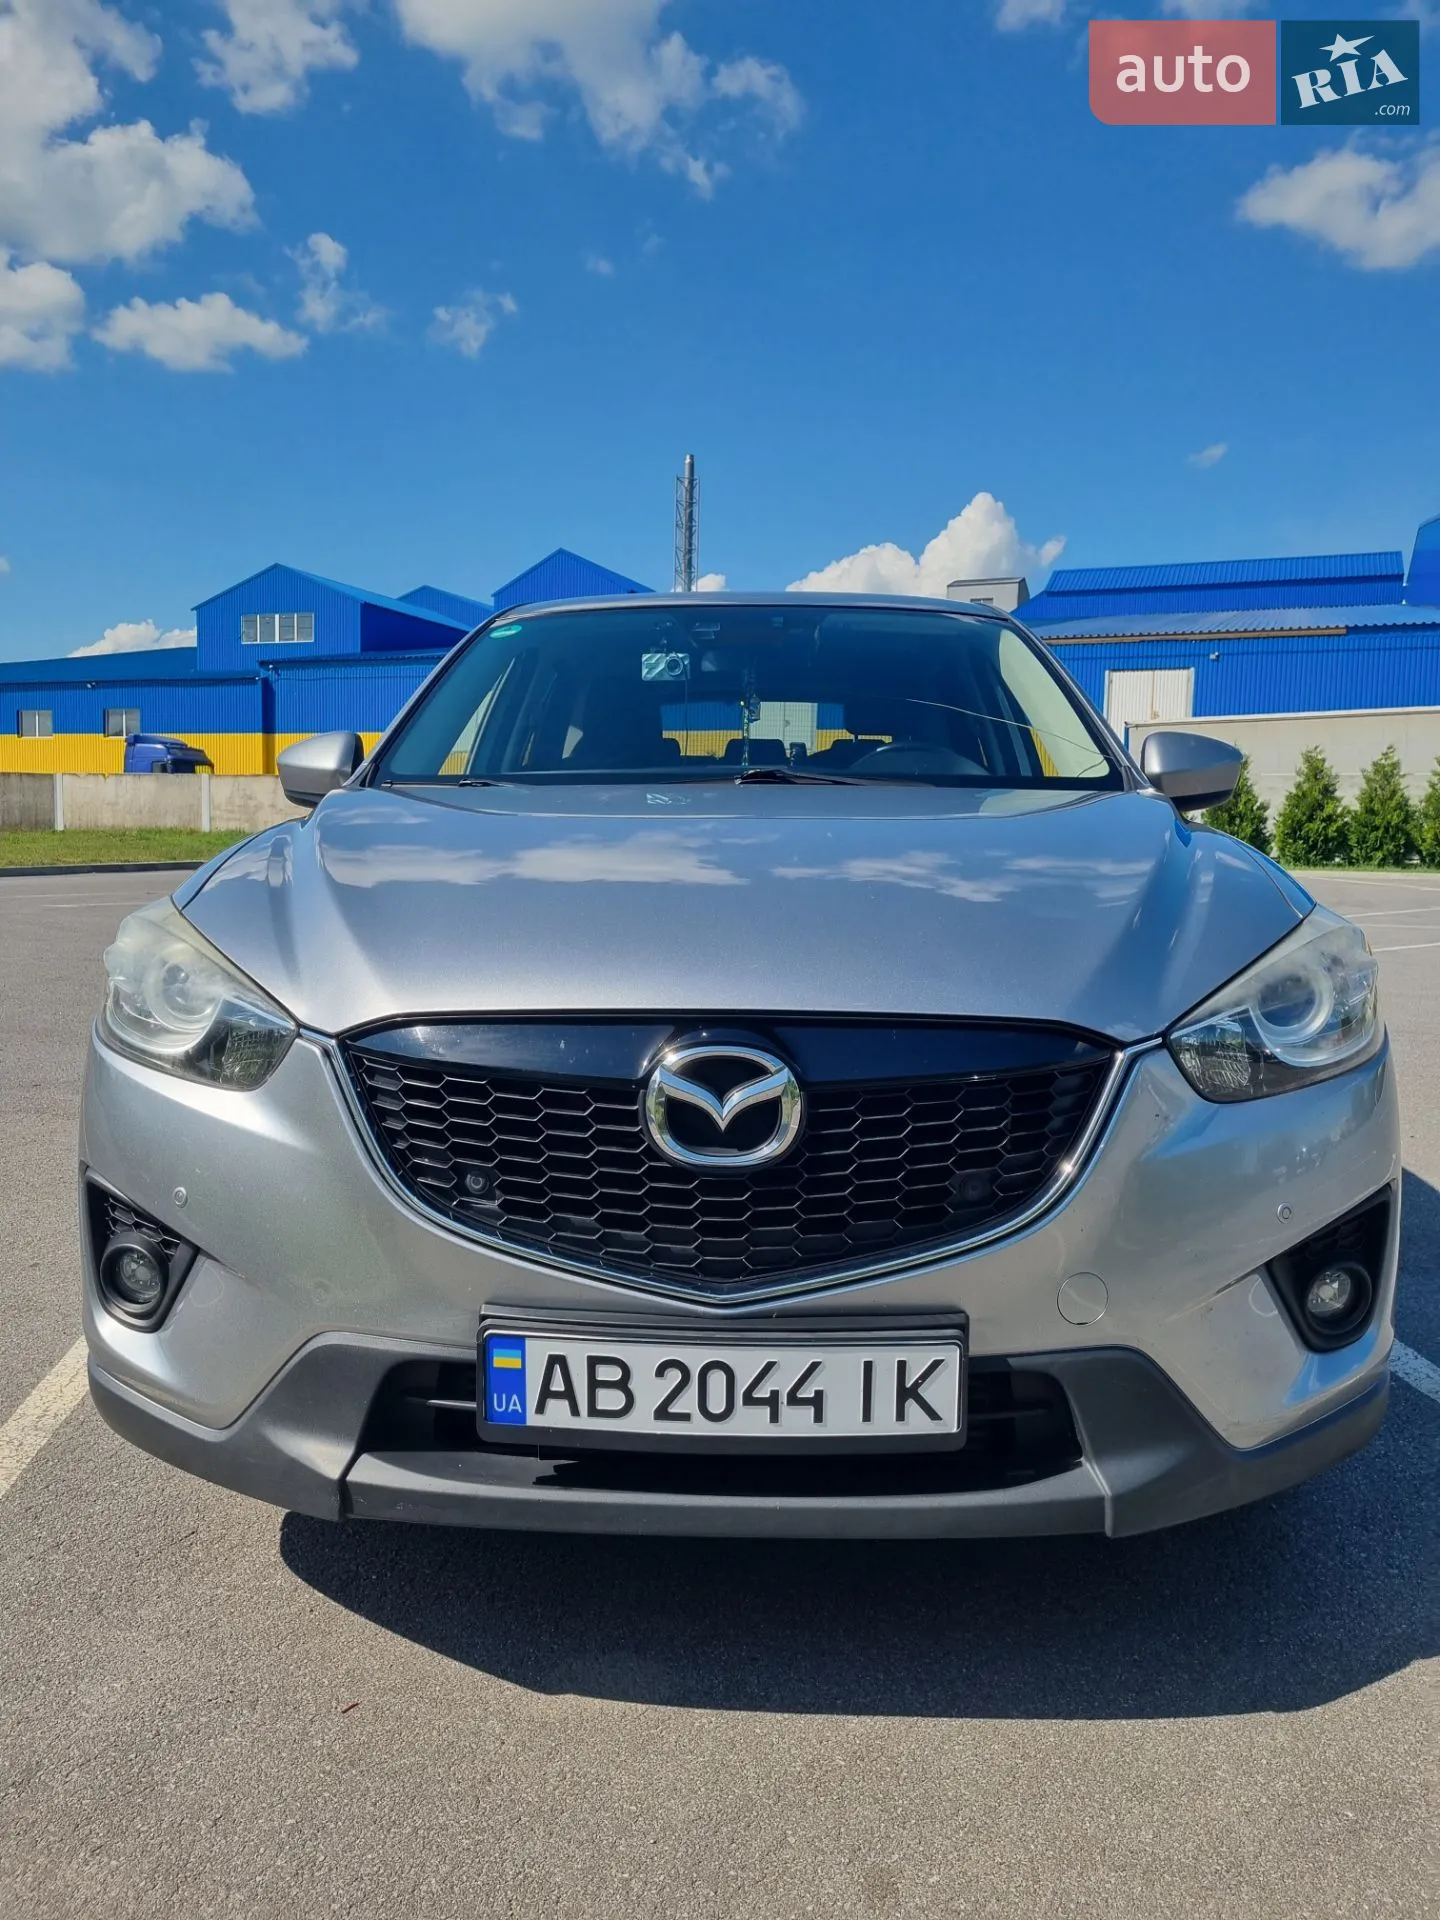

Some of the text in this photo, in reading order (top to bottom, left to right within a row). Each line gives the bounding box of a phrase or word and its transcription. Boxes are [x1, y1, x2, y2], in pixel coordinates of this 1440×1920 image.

[493, 1393, 522, 1413] UA
[534, 1354, 946, 1425] AB 2044 IK
